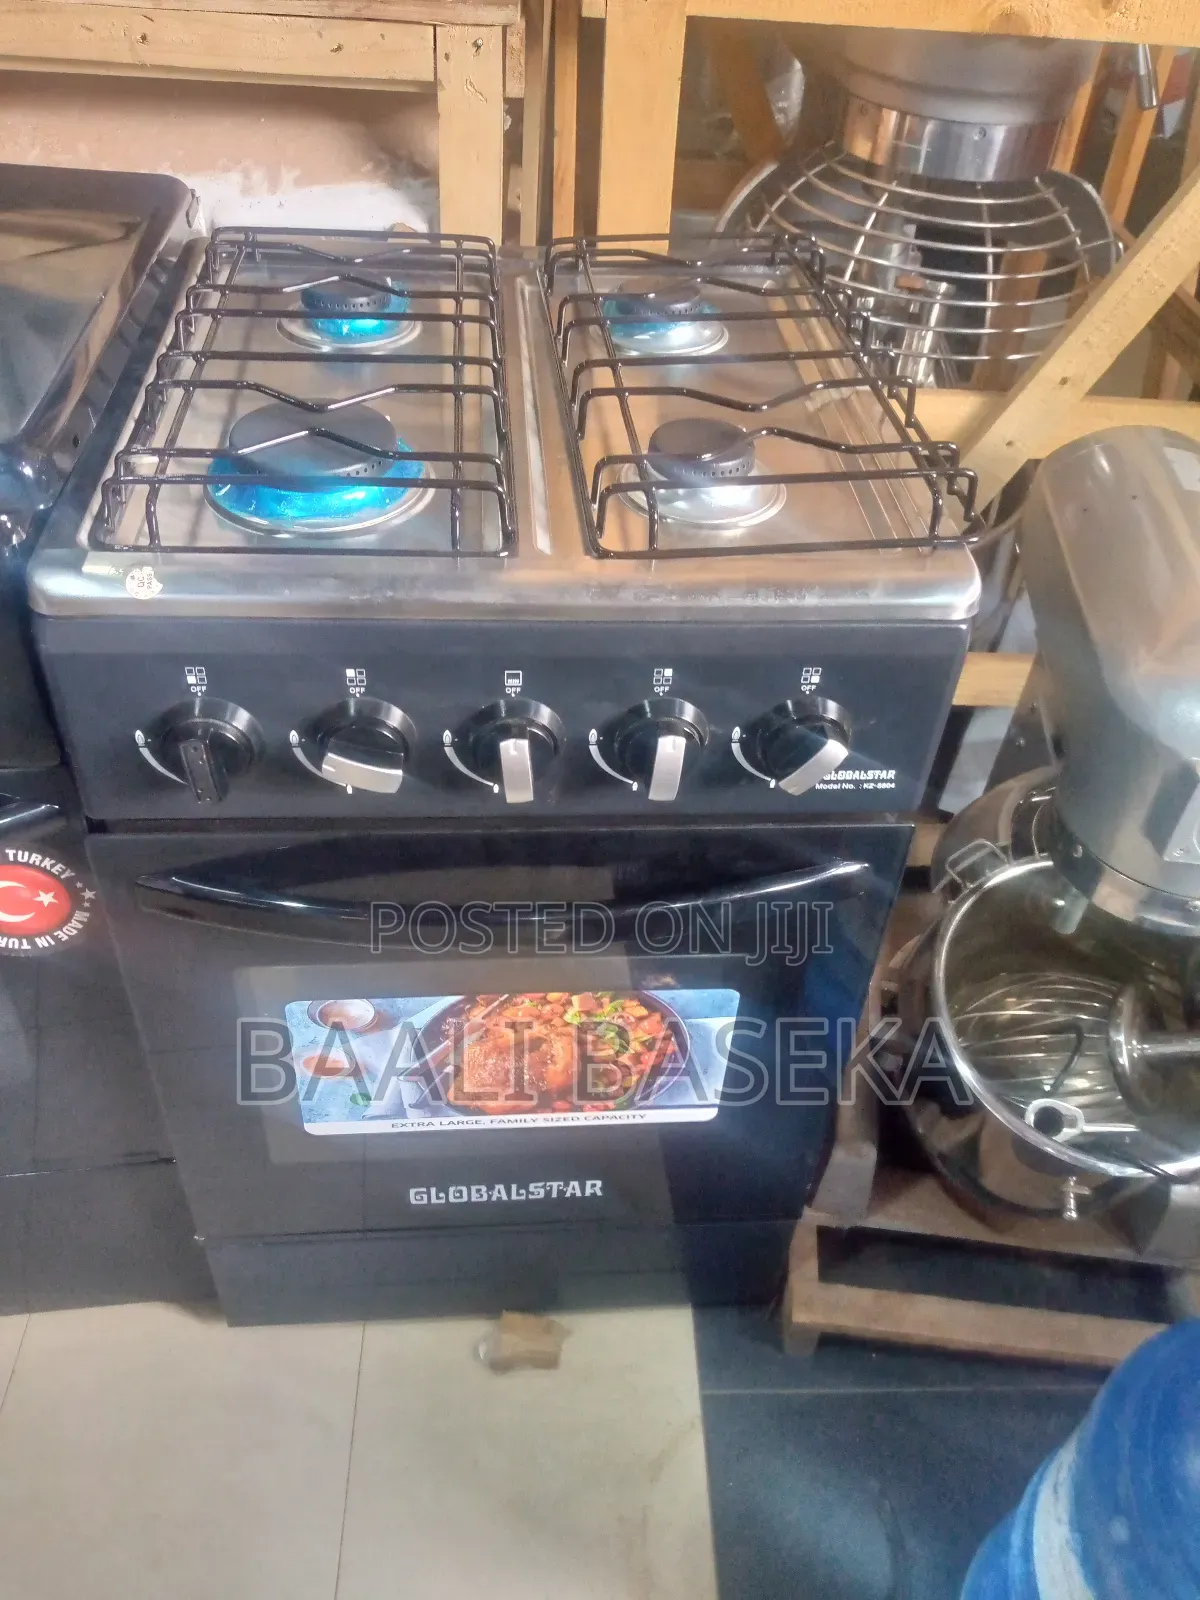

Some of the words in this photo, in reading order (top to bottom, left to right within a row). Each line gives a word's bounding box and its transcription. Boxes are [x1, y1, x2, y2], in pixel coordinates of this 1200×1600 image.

[190, 685, 207, 693] OFF
[349, 686, 366, 694] OFF
[505, 686, 521, 694] OFF
[653, 685, 670, 693] OFF
[815, 782, 841, 790] Model
[841, 782, 856, 790] No.
[5, 849, 76, 879] TURKEY
[53, 910, 90, 942] MADE
[34, 934, 56, 949] IN
[391, 1121, 435, 1129] EXTRA
[490, 1117, 539, 1125] FAMILY
[584, 1113, 648, 1122] CAPACITY
[409, 1179, 603, 1205] GLOBALSTAR
